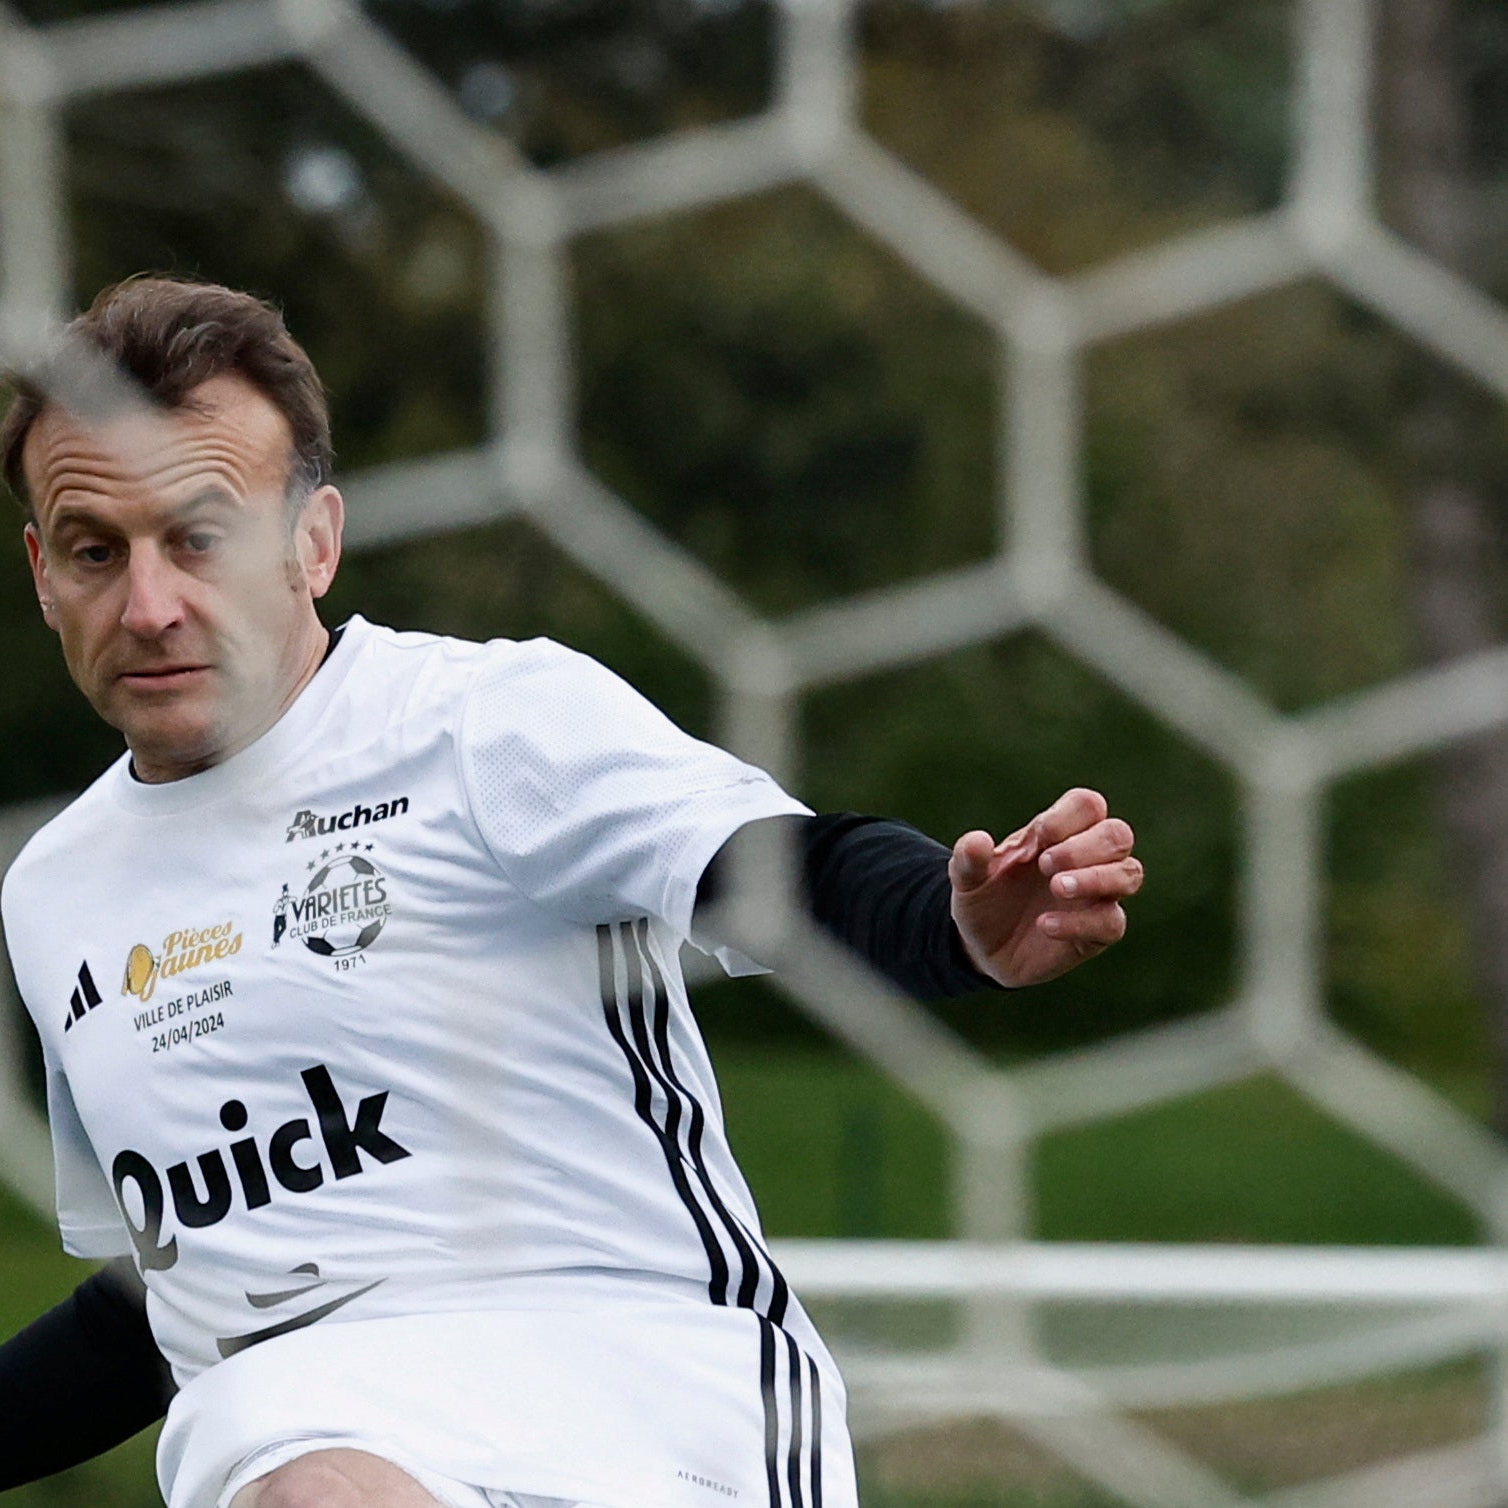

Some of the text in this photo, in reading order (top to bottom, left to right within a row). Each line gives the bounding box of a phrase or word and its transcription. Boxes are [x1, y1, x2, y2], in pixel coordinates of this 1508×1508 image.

[286, 796, 409, 843] Auchan
[163, 920, 233, 957] Pièces
[289, 903, 393, 939] CLUB DE FRANCE
[334, 953, 367, 973] 1971
[134, 980, 234, 1032] VILLE DE PLAISIR
[152, 1012, 225, 1053] 24/04/2024
[112, 1064, 412, 1272] Quick
[677, 1470, 739, 1499] AEROREADY
